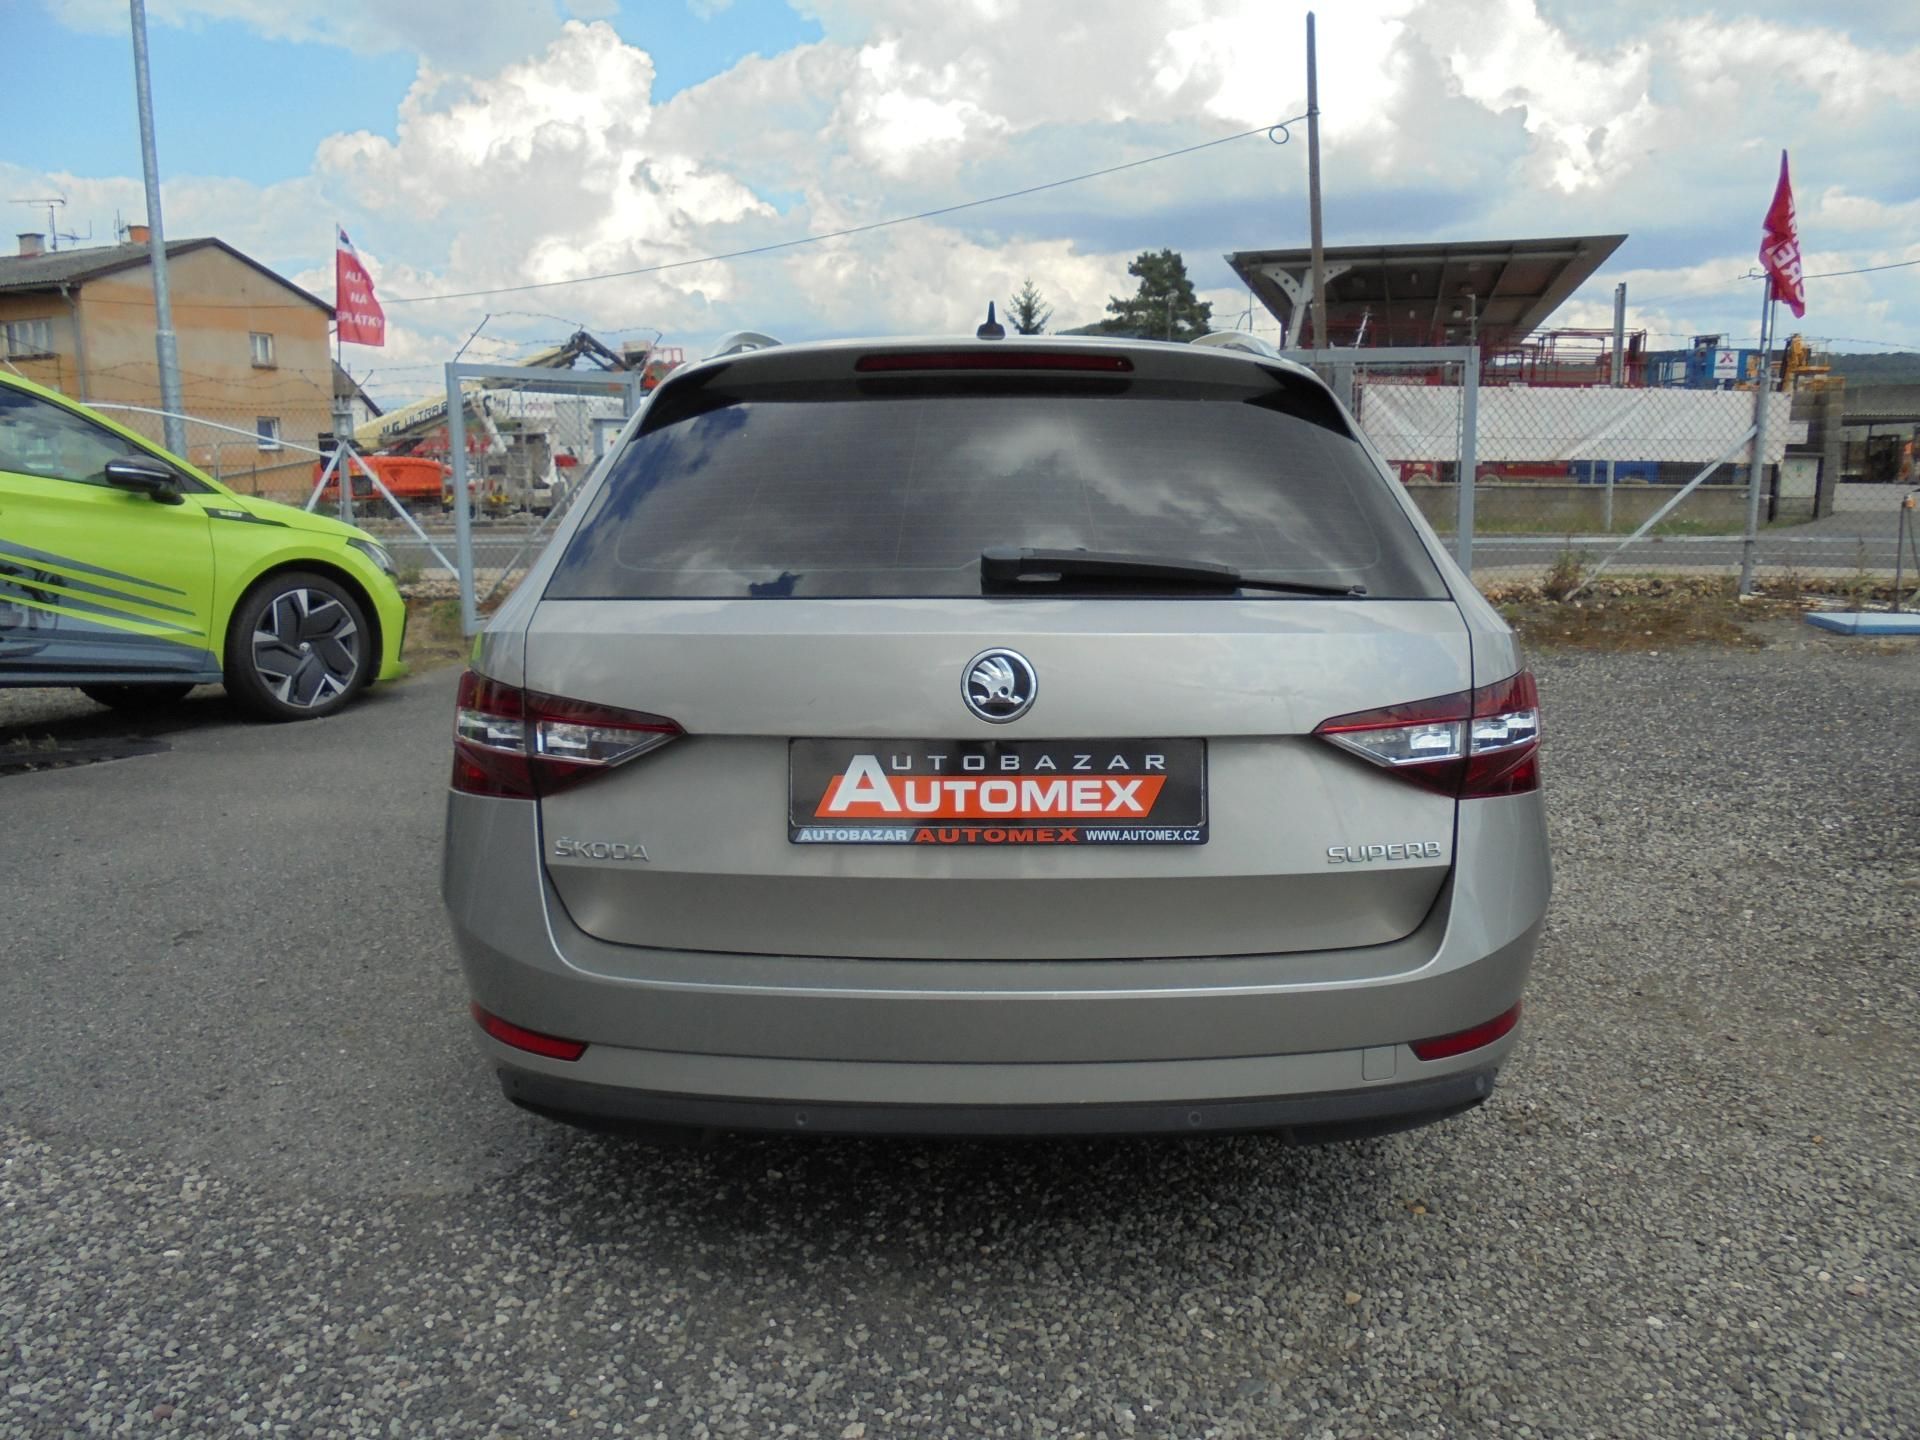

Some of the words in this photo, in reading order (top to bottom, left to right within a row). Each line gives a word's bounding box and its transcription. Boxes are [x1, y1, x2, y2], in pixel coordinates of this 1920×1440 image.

[350, 291, 368, 304] NA
[828, 754, 1144, 812] AUTOMEX
[800, 829, 909, 842] AUTOBAZAR
[915, 828, 1079, 842] AUTOMEX
[1086, 829, 1201, 842] WWW.AUTOMEX.CZ
[554, 835, 650, 862] ŠKODA
[1326, 841, 1442, 864] SUPERB
